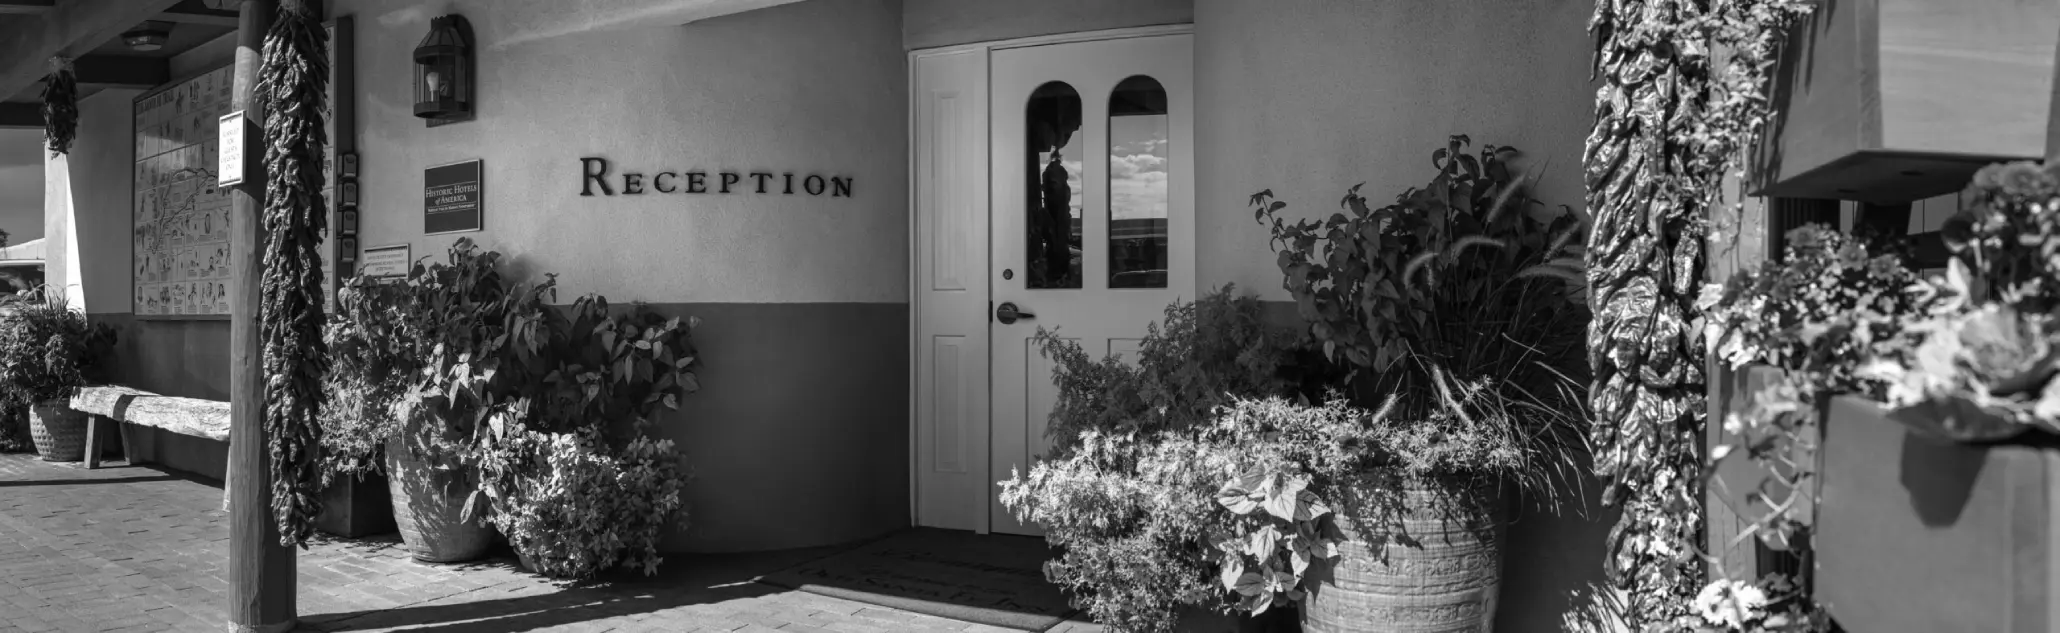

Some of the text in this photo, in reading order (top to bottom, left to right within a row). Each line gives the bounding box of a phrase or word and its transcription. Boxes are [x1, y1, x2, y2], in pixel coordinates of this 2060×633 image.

[579, 157, 853, 198] RECEPTION
[425, 184, 477, 198] HISTORIC HOTELS
[440, 194, 467, 204] AMERICA
